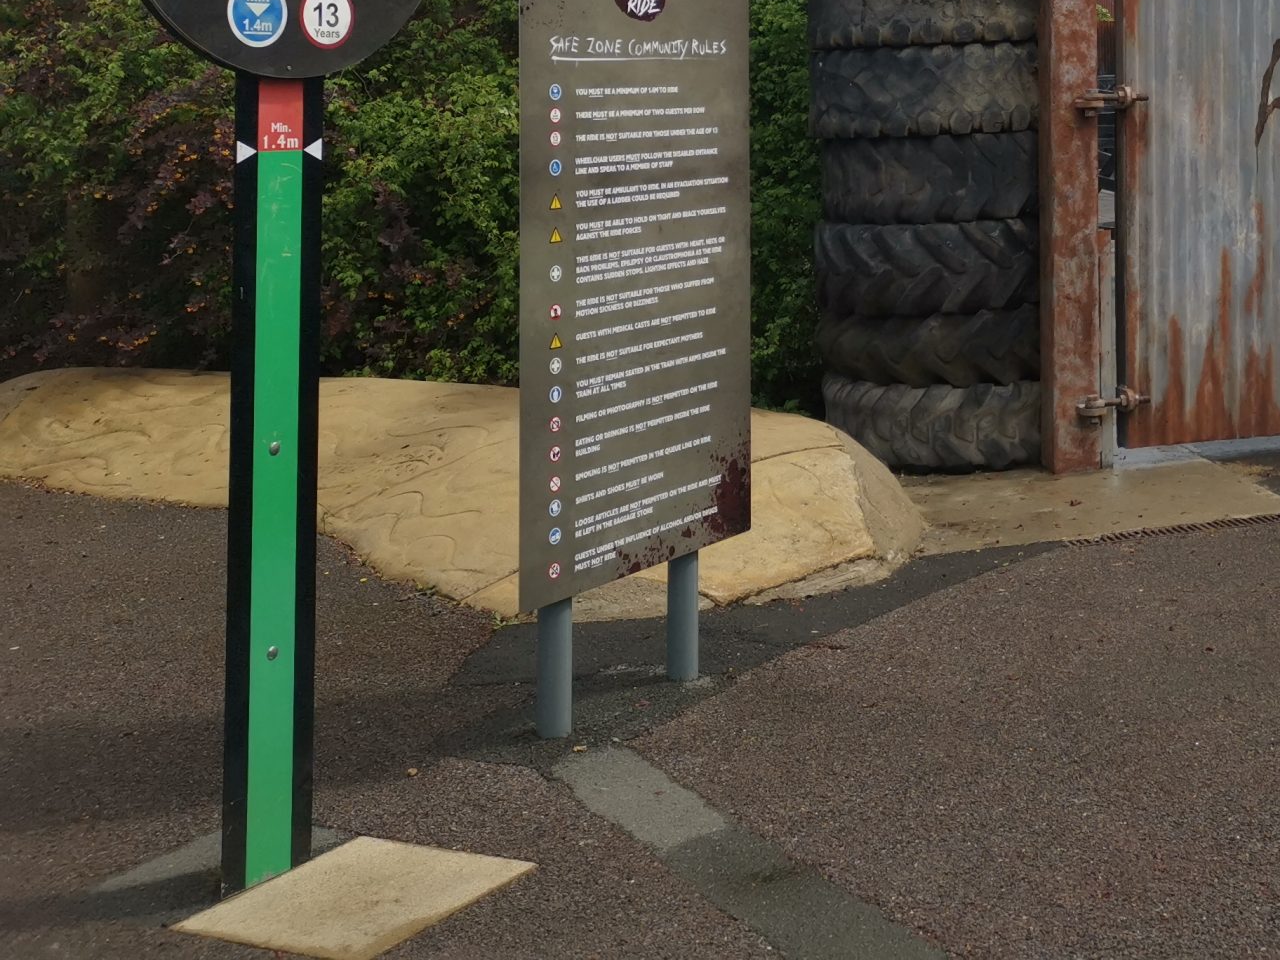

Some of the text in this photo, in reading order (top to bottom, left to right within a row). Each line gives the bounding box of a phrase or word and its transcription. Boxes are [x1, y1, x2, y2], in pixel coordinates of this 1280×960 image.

[313, 2, 339, 28] 13
[243, 18, 273, 32] 1.4m
[314, 29, 340, 39] Years
[550, 36, 580, 54] SAFE
[586, 38, 623, 54] ZONE
[271, 123, 292, 133] Min.
[263, 135, 300, 149] 1.4m
